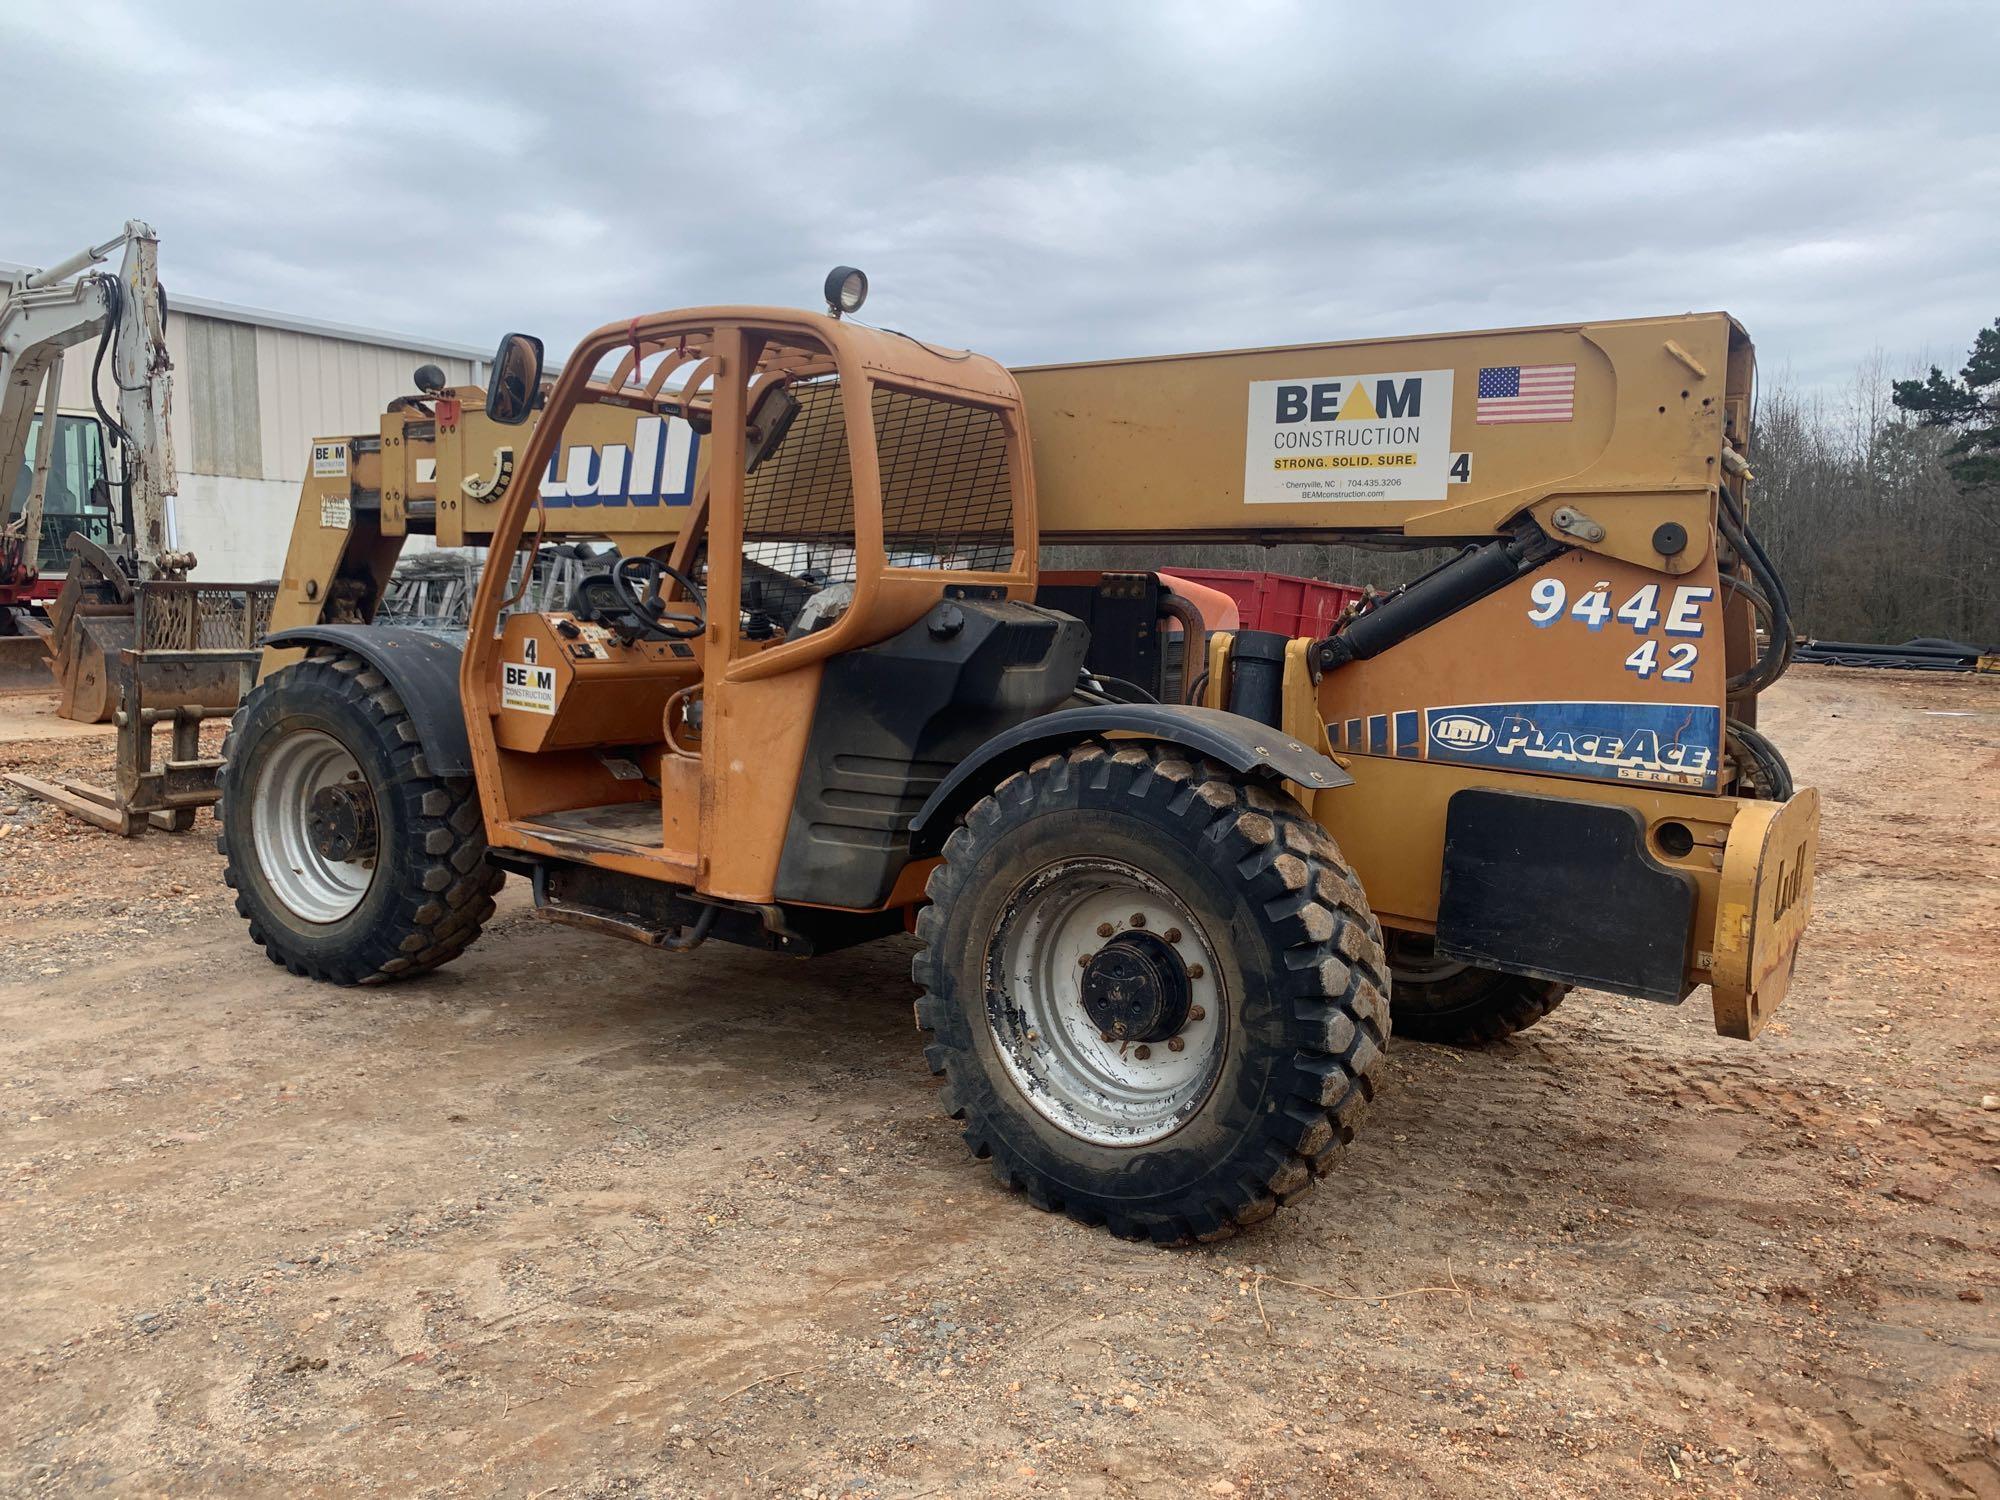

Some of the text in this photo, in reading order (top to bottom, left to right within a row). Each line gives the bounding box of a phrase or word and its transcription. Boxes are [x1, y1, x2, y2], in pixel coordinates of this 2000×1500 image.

[1275, 378, 1422, 424] BEAM
[1274, 427, 1420, 449] CONSTRUCTION
[315, 447, 345, 460] BEAM
[1274, 455, 1417, 469] STRONG. SOLID. SURE.
[1450, 453, 1470, 483] 4
[1286, 479, 1402, 489] Cherryville, NC 704.435.3206
[1528, 578, 1714, 637] 944E
[525, 639, 536, 663] 4
[1624, 640, 1699, 683] 42
[506, 667, 552, 690] BEAM
